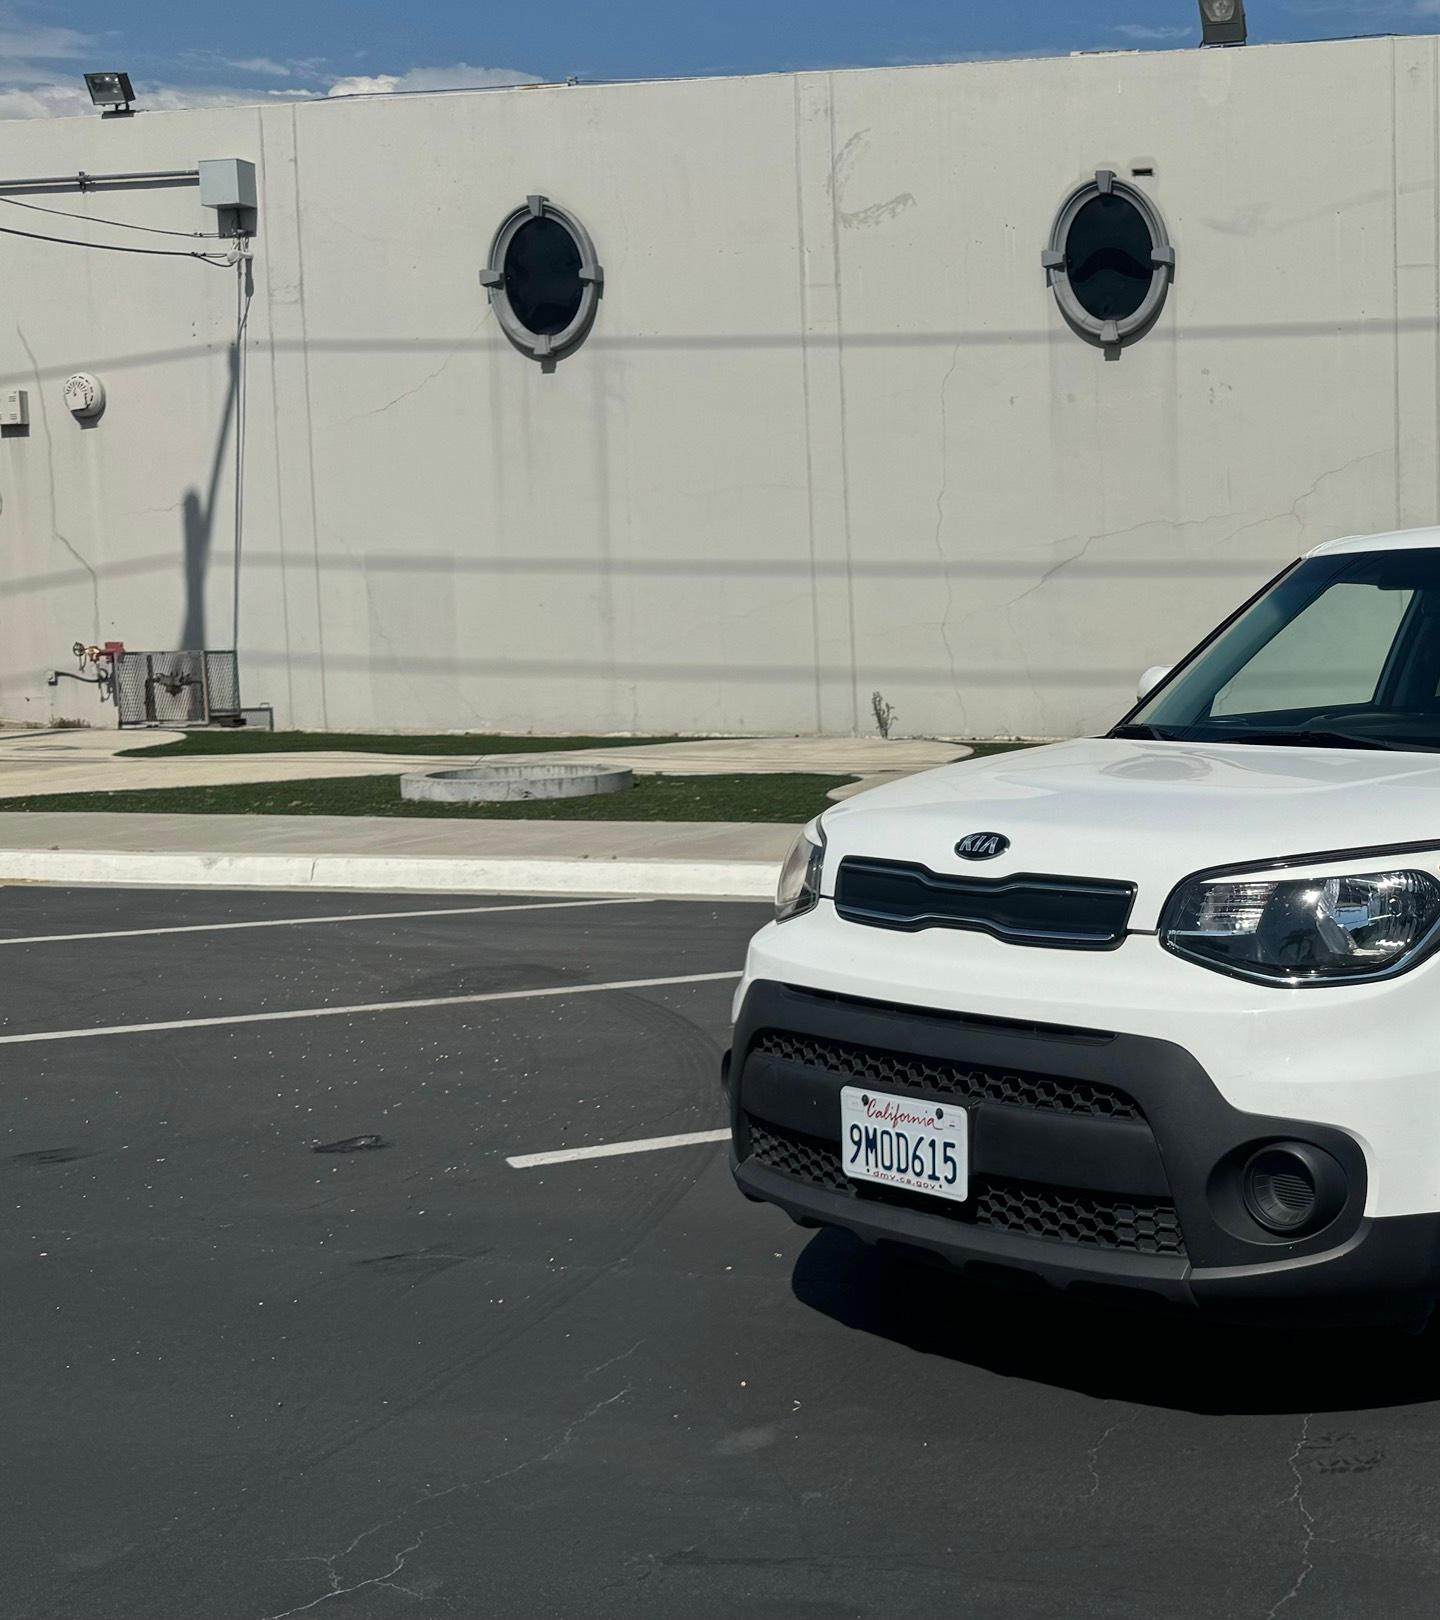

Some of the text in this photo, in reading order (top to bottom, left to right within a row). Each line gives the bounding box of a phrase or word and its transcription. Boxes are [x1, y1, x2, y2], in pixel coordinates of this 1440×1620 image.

[958, 834, 999, 854] KIA
[866, 1098, 943, 1131] California
[850, 1123, 957, 1185] 9MOD615
[873, 1171, 936, 1190] dmv.ca.gov
